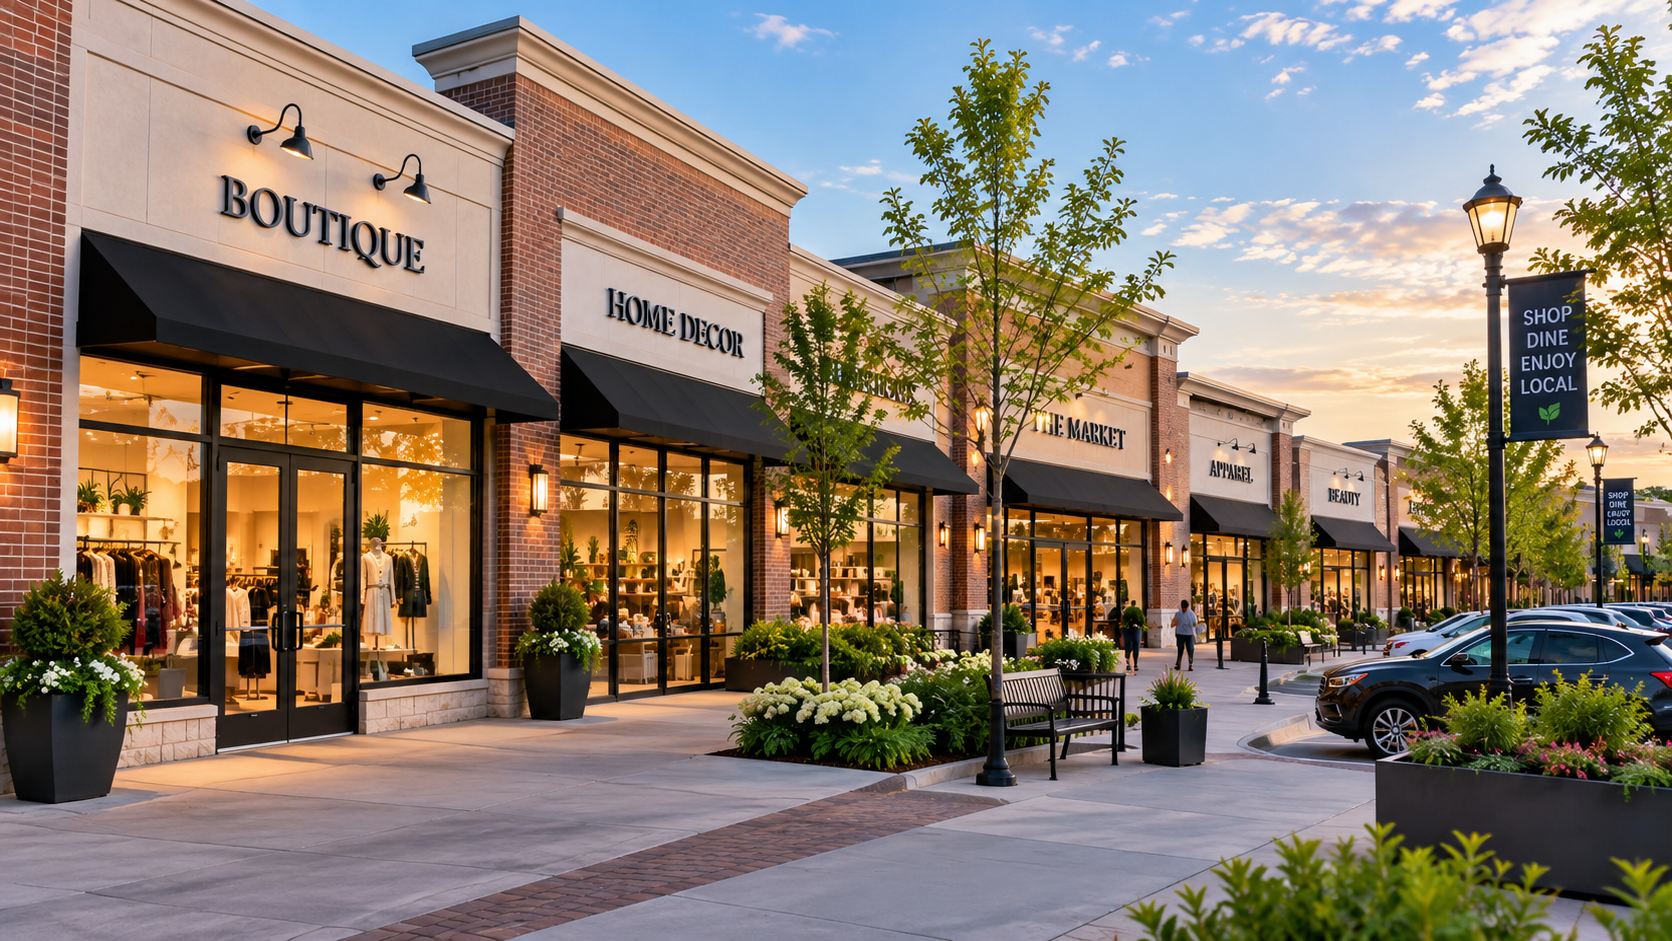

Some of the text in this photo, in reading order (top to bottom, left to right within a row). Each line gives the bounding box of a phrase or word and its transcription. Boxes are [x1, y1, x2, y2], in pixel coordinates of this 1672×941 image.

[220, 175, 426, 275] BOUTIQUE
[606, 287, 745, 359] HOME DECOR
[1523, 305, 1572, 326] SHOP
[1527, 329, 1568, 349] DINE
[1521, 352, 1577, 371] ENJOY
[1521, 375, 1577, 395] LOCAL
[1067, 417, 1126, 450] MARKET
[1209, 459, 1253, 483] APPAREL
[1328, 488, 1361, 506] BEAUTY
[1608, 491, 1629, 499] SHOP
